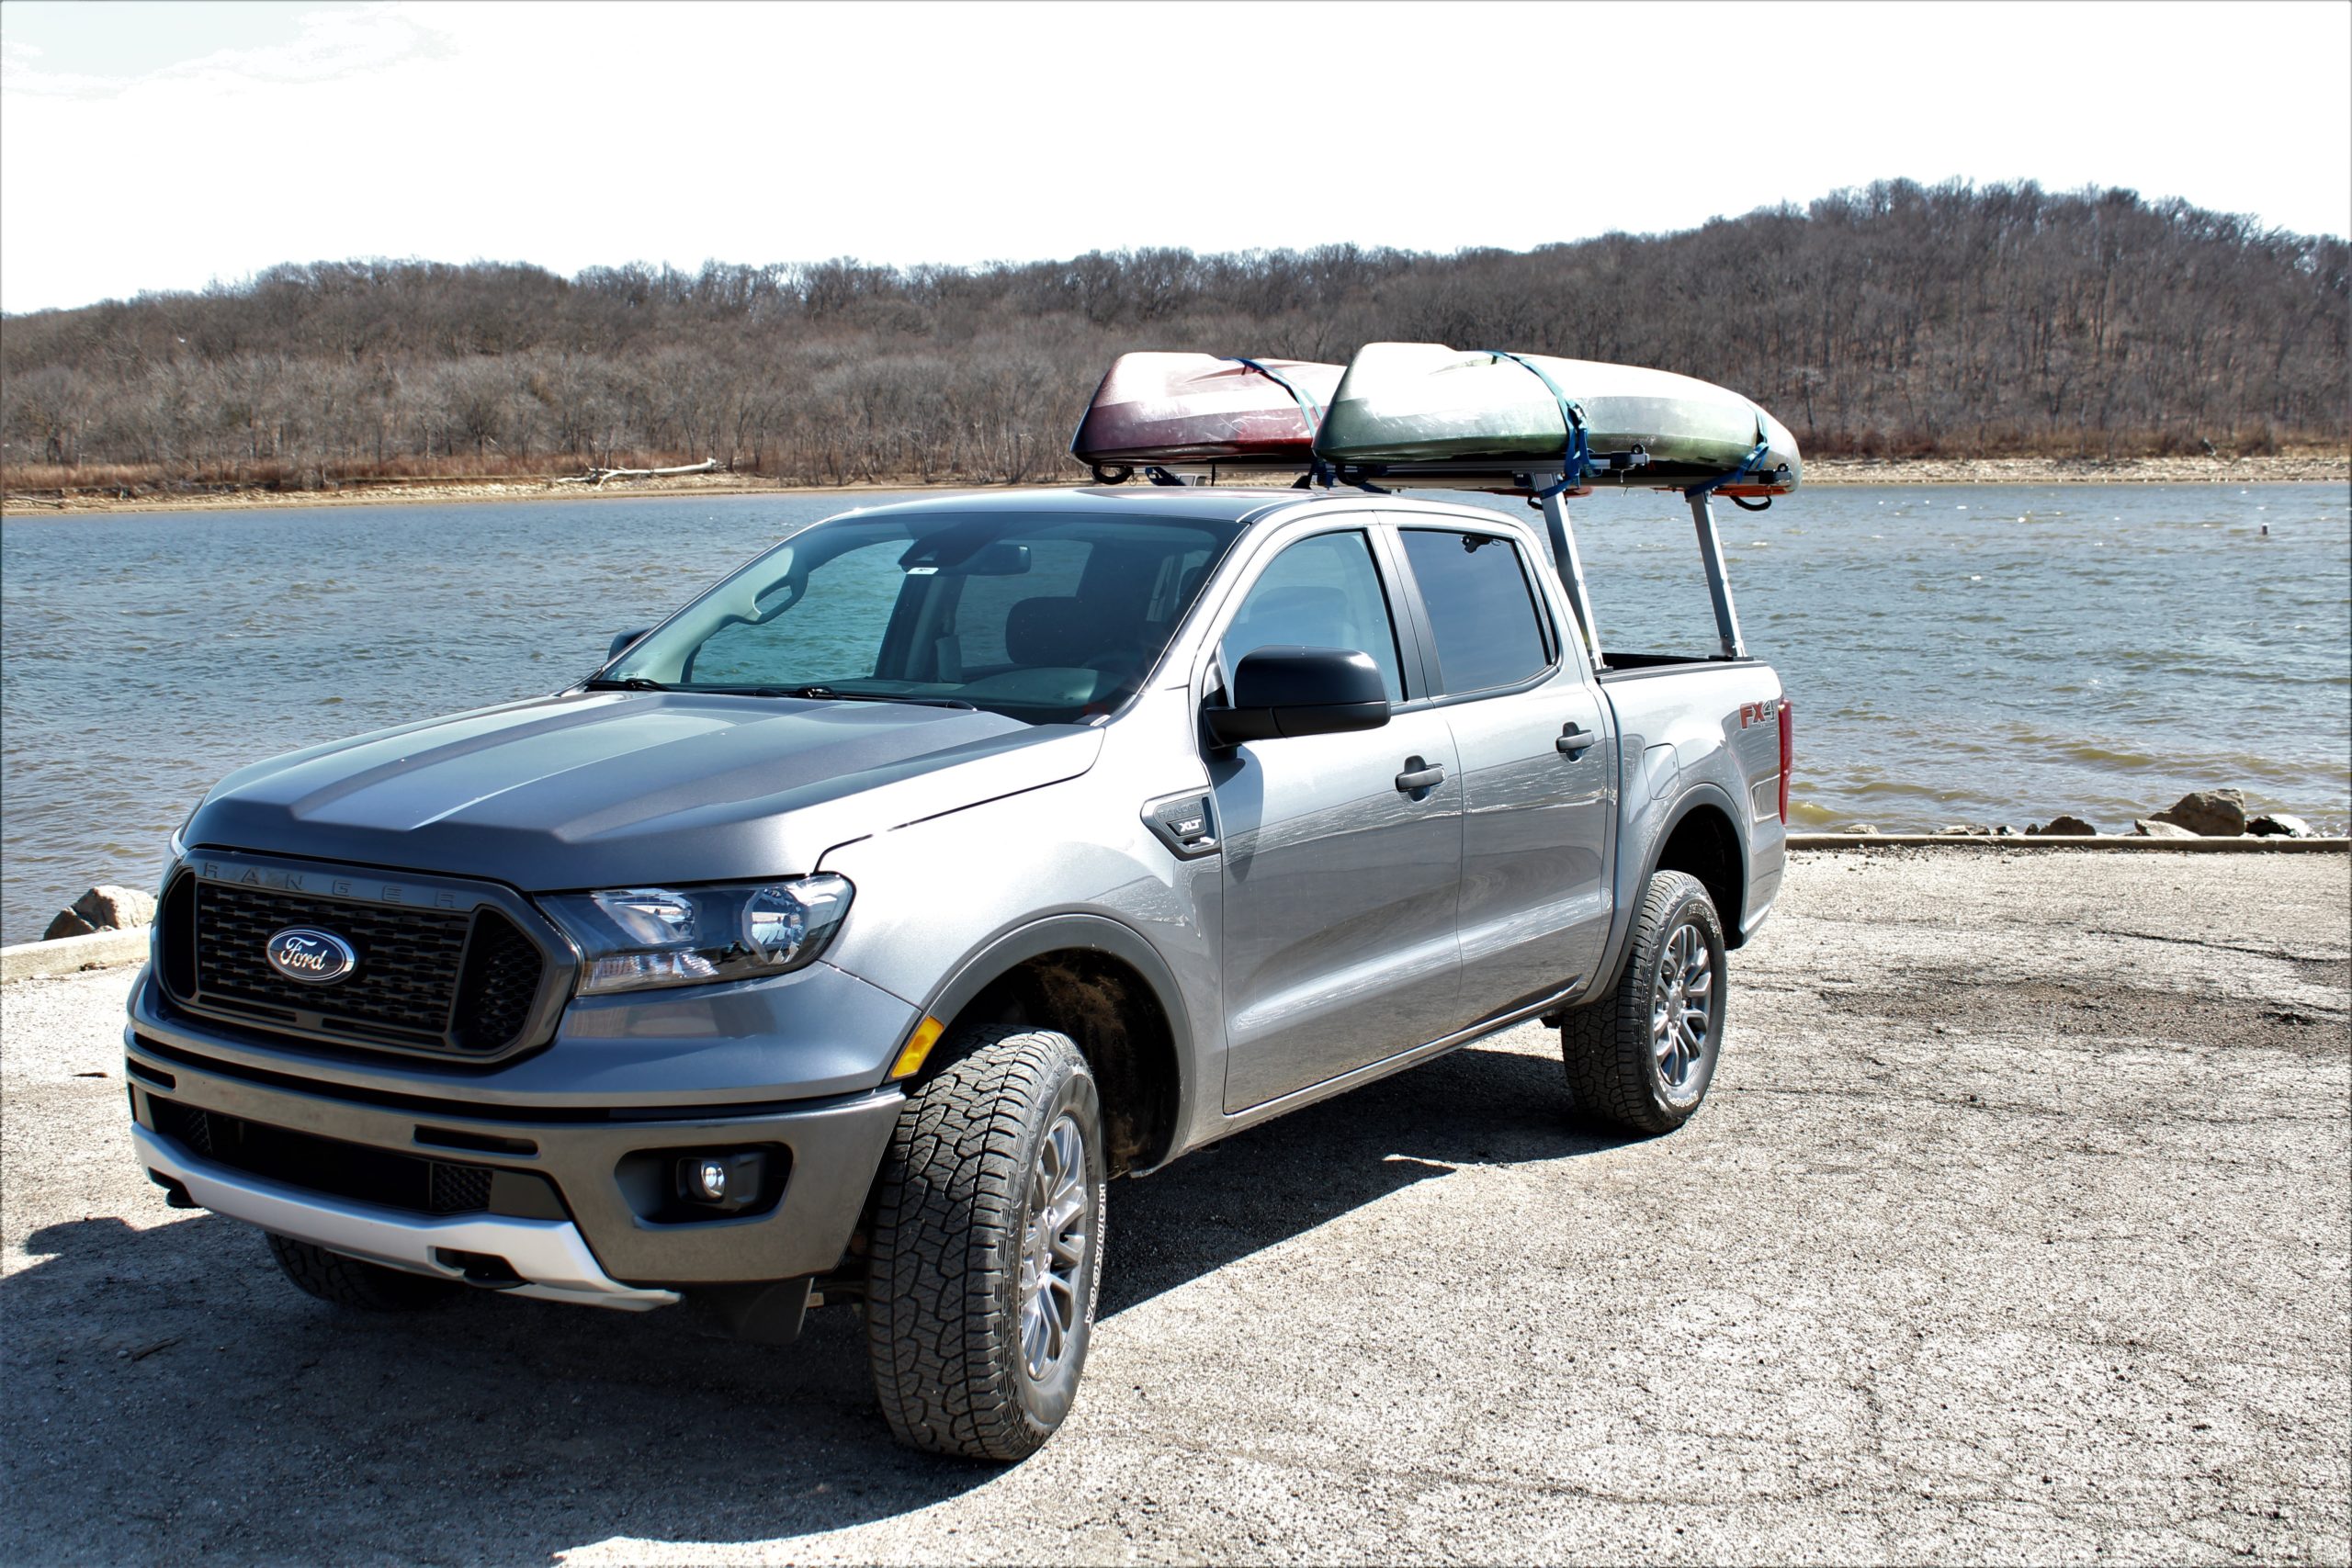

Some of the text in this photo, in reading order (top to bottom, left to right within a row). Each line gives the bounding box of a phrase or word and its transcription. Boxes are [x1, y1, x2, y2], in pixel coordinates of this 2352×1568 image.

[1739, 699, 1775, 729] FX4
[1179, 818, 1202, 833] XLT
[203, 862, 456, 908] RANGER
[279, 936, 329, 971] Ford
